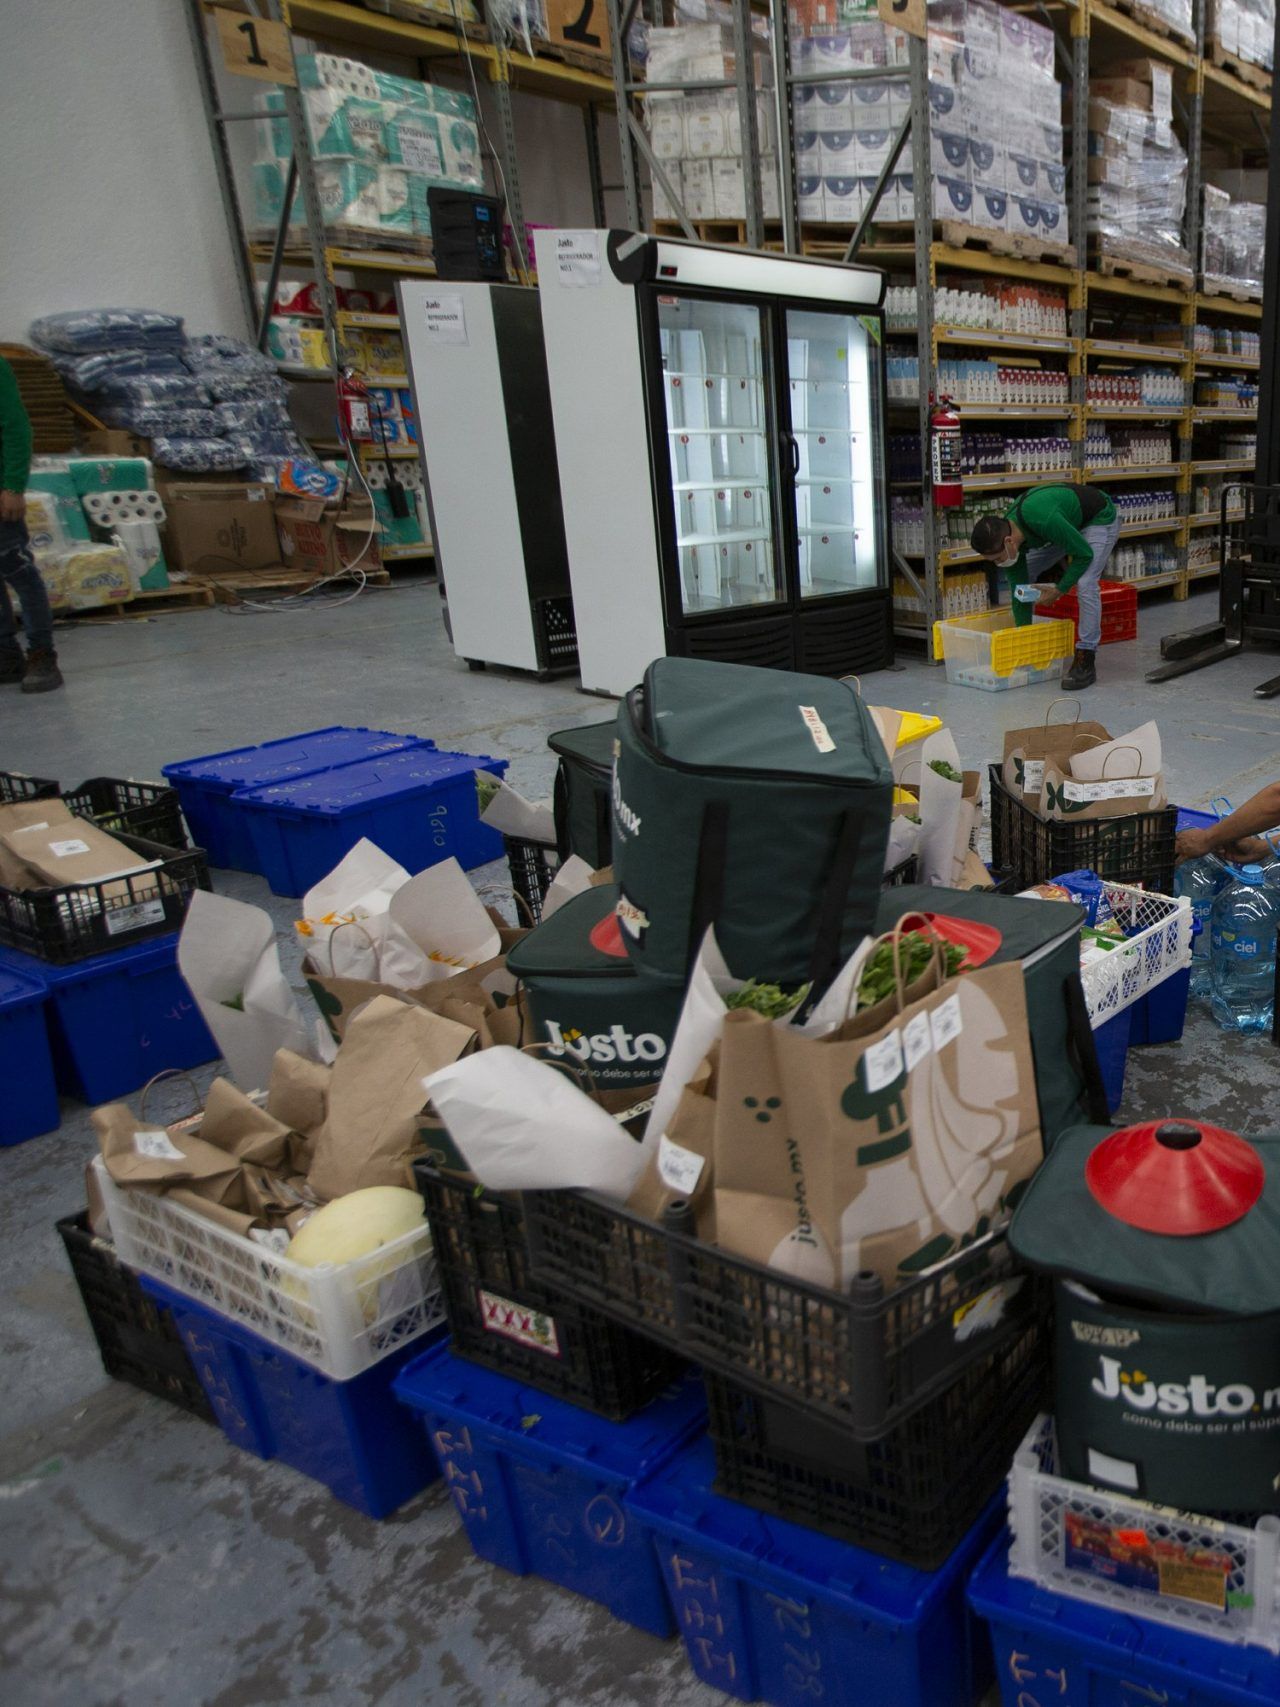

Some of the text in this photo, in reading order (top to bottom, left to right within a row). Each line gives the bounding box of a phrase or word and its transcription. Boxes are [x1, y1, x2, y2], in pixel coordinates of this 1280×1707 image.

[237, 20, 269, 67] 1
[1233, 940, 1257, 954] ciel
[1122, 1411, 1163, 1430] como
[1165, 1418, 1203, 1434] debe
[1206, 1420, 1230, 1434] ser
[1232, 1418, 1246, 1432] el
